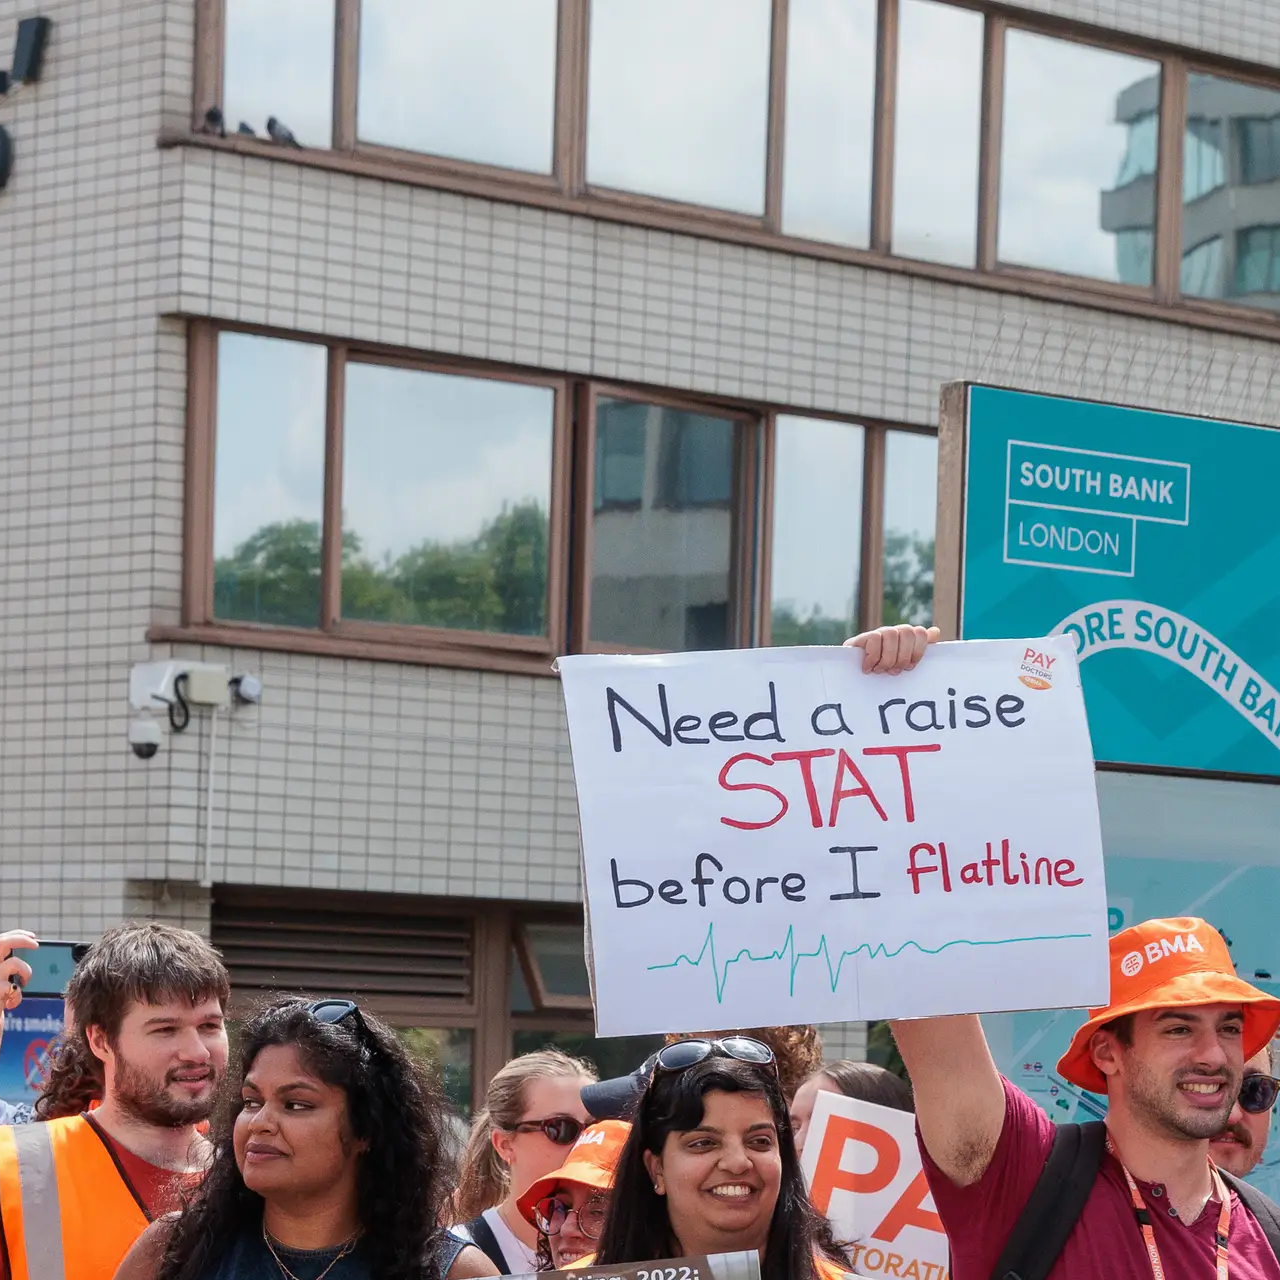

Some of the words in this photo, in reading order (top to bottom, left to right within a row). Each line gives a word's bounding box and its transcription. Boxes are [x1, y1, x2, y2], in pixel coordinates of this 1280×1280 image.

[1019, 460, 1102, 496] SOUTH
[1109, 470, 1175, 506] BANK
[1017, 521, 1120, 555] LONDON
[1021, 664, 1052, 680] DOCTORS
[1024, 648, 1056, 669] PAY
[1133, 611, 1239, 690] SOUTH
[606, 681, 786, 753] Need
[810, 703, 851, 735] a
[878, 688, 1027, 738] raise
[719, 744, 941, 830] STAT
[611, 853, 807, 910] before
[829, 846, 879, 901] I
[906, 838, 1084, 896] flatline
[1144, 934, 1204, 964] BMA
[809, 1114, 948, 1243] PA
[1147, 1244, 1159, 1265] NOW
